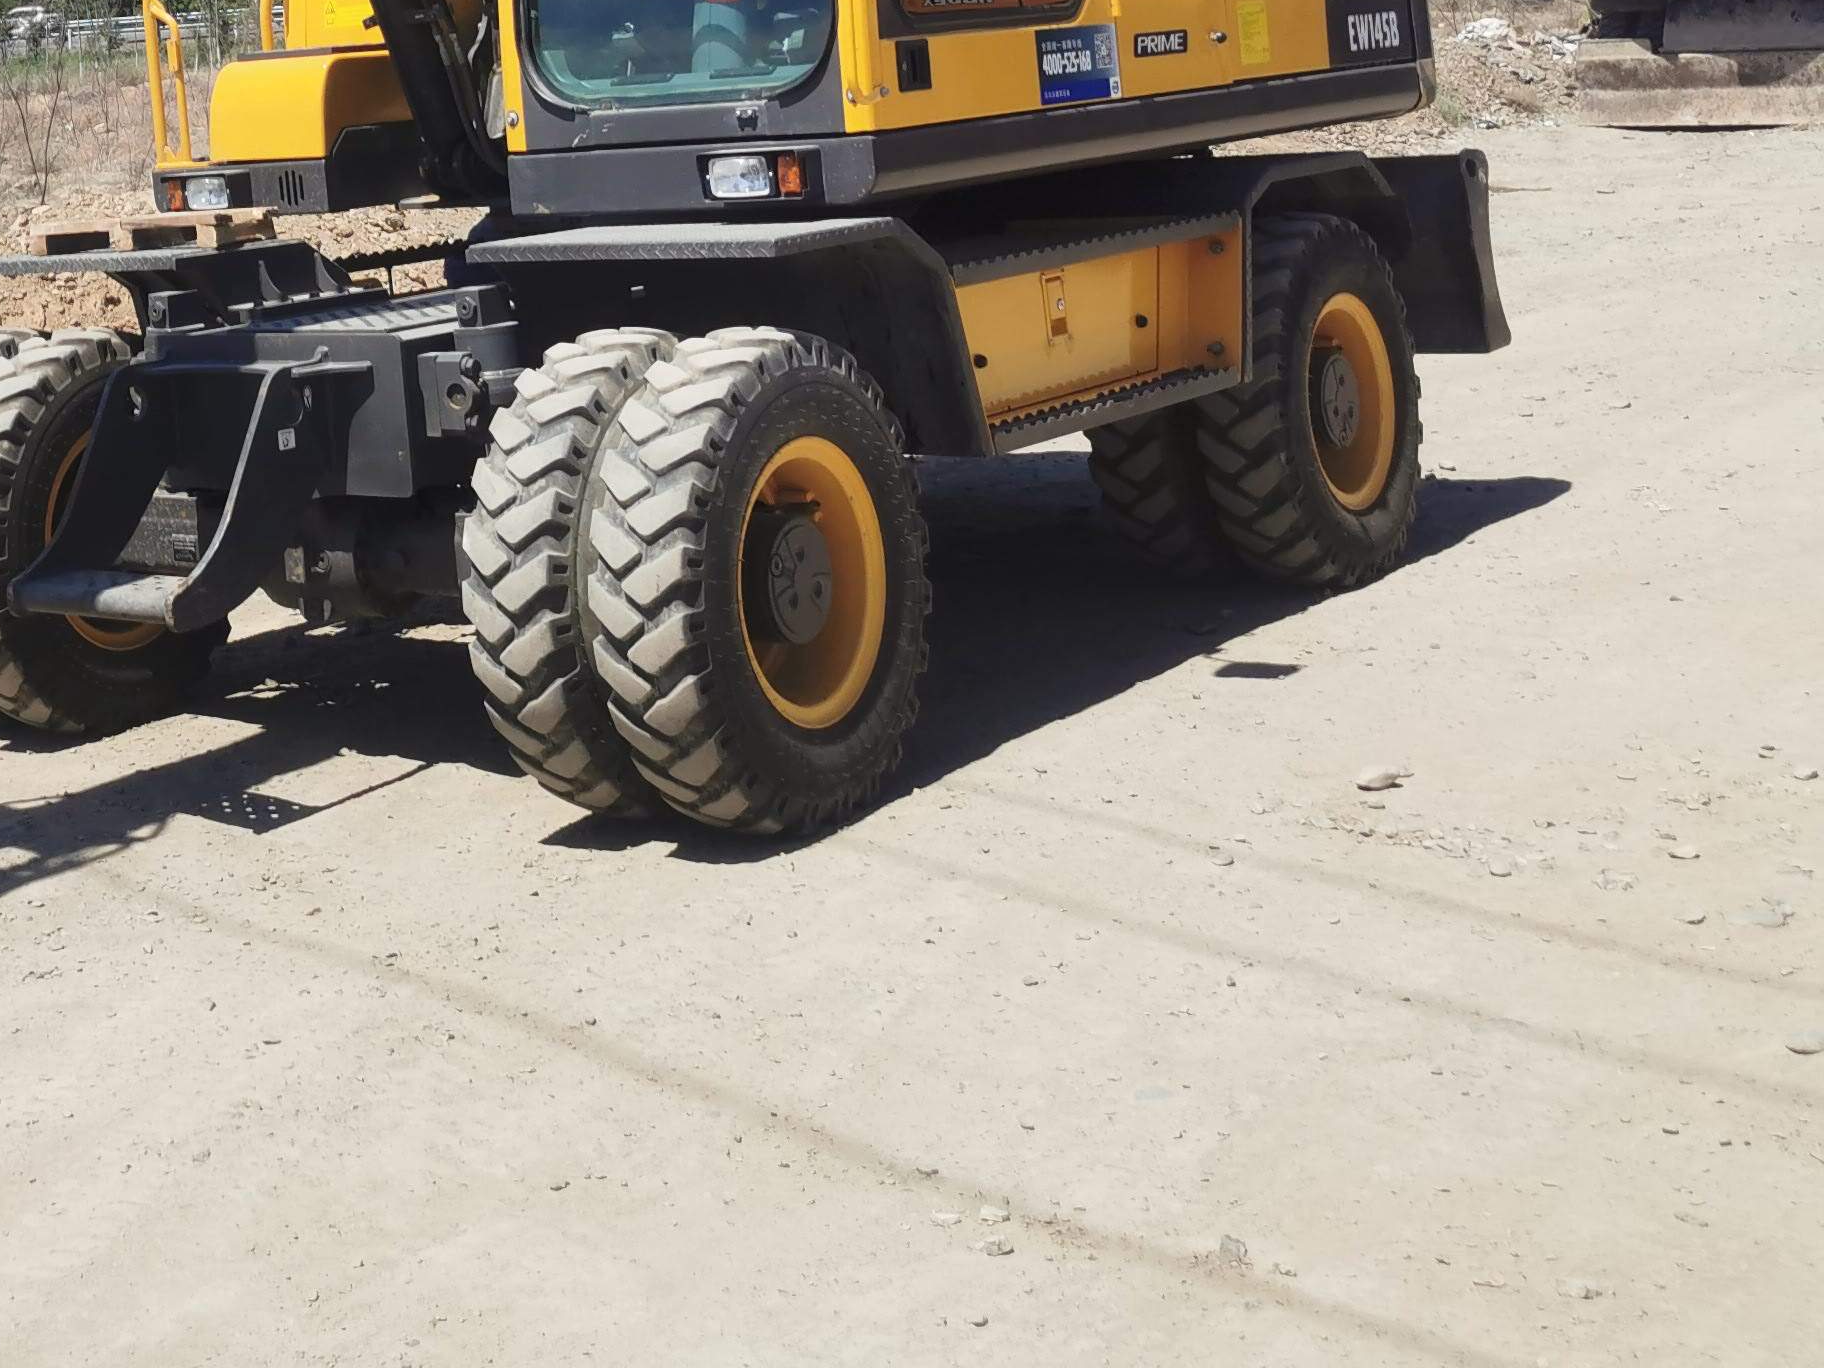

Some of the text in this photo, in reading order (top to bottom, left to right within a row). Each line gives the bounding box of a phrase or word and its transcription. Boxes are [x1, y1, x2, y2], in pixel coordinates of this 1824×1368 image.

[1137, 32, 1185, 55] PRIME
[1347, 11, 1400, 52] EW145B
[1042, 50, 1092, 76] 4000-525-168
